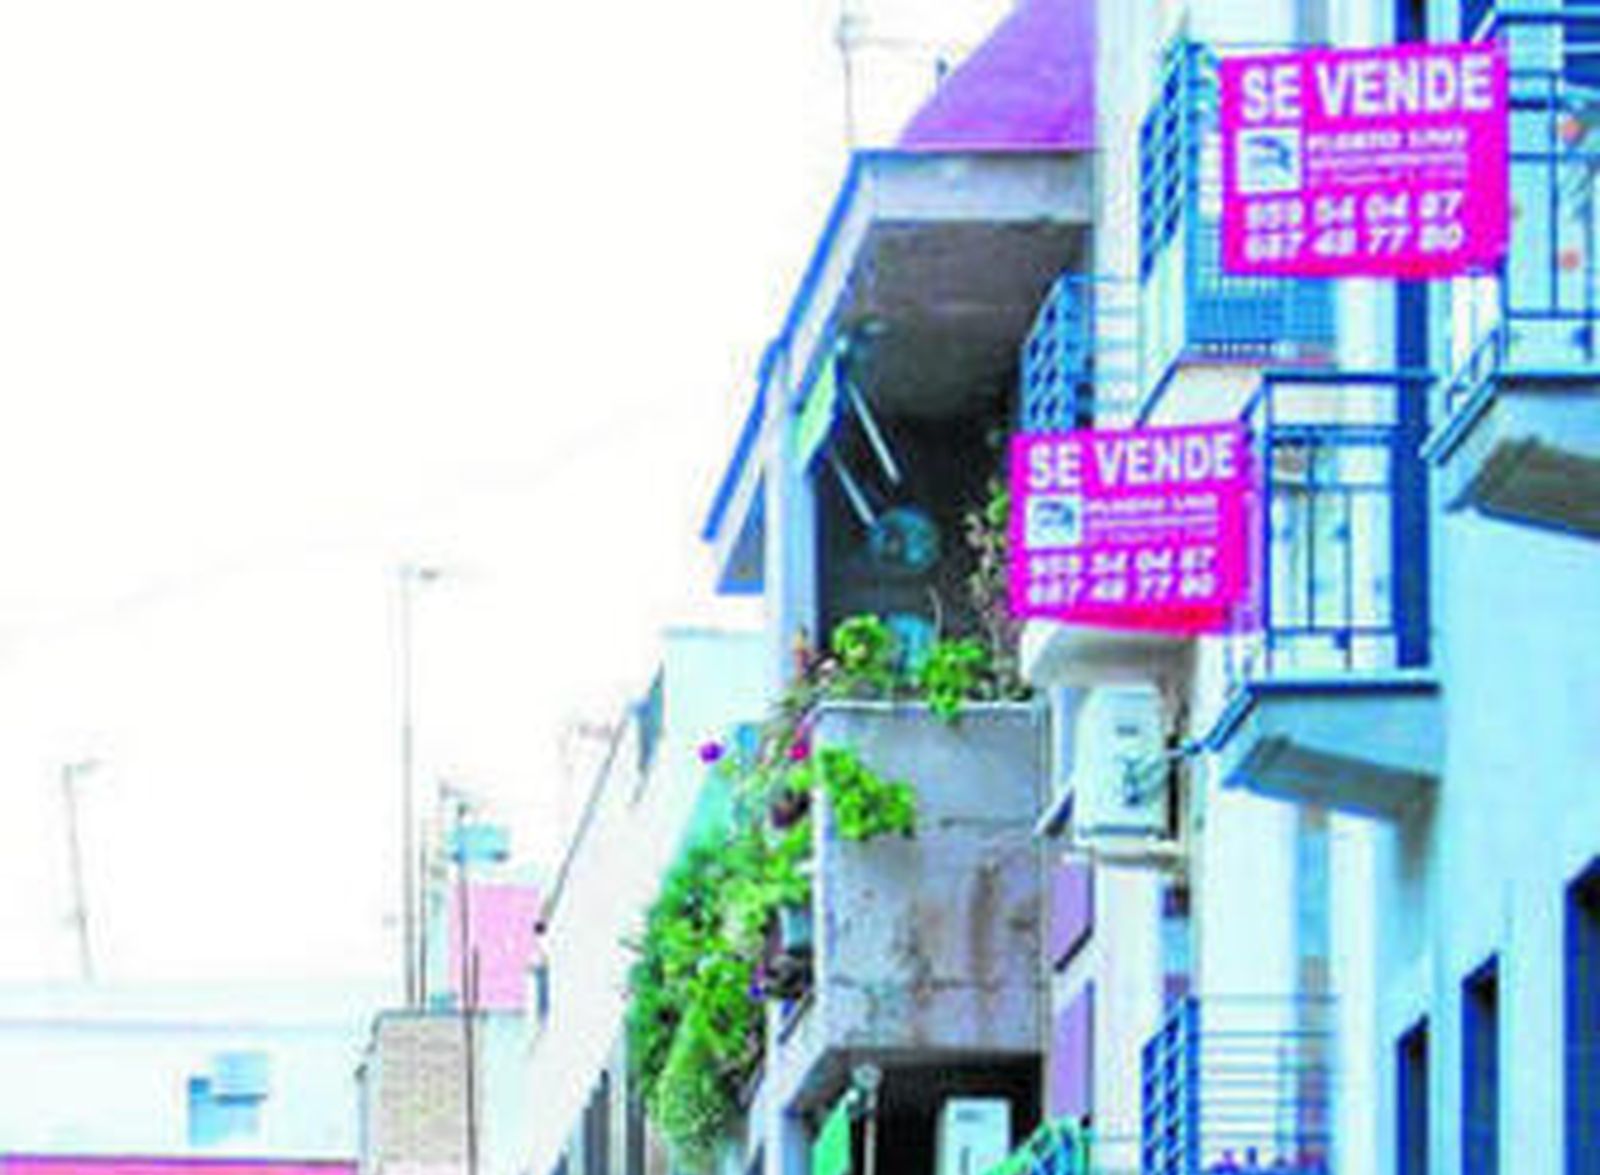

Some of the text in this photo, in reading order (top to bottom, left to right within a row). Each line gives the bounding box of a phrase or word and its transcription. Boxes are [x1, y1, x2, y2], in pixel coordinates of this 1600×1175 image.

[1242, 55, 1494, 121] SE VENDE
[1366, 224, 1412, 255] 77
[1029, 432, 1236, 488] SE VENDE
[1136, 573, 1173, 600] 77
